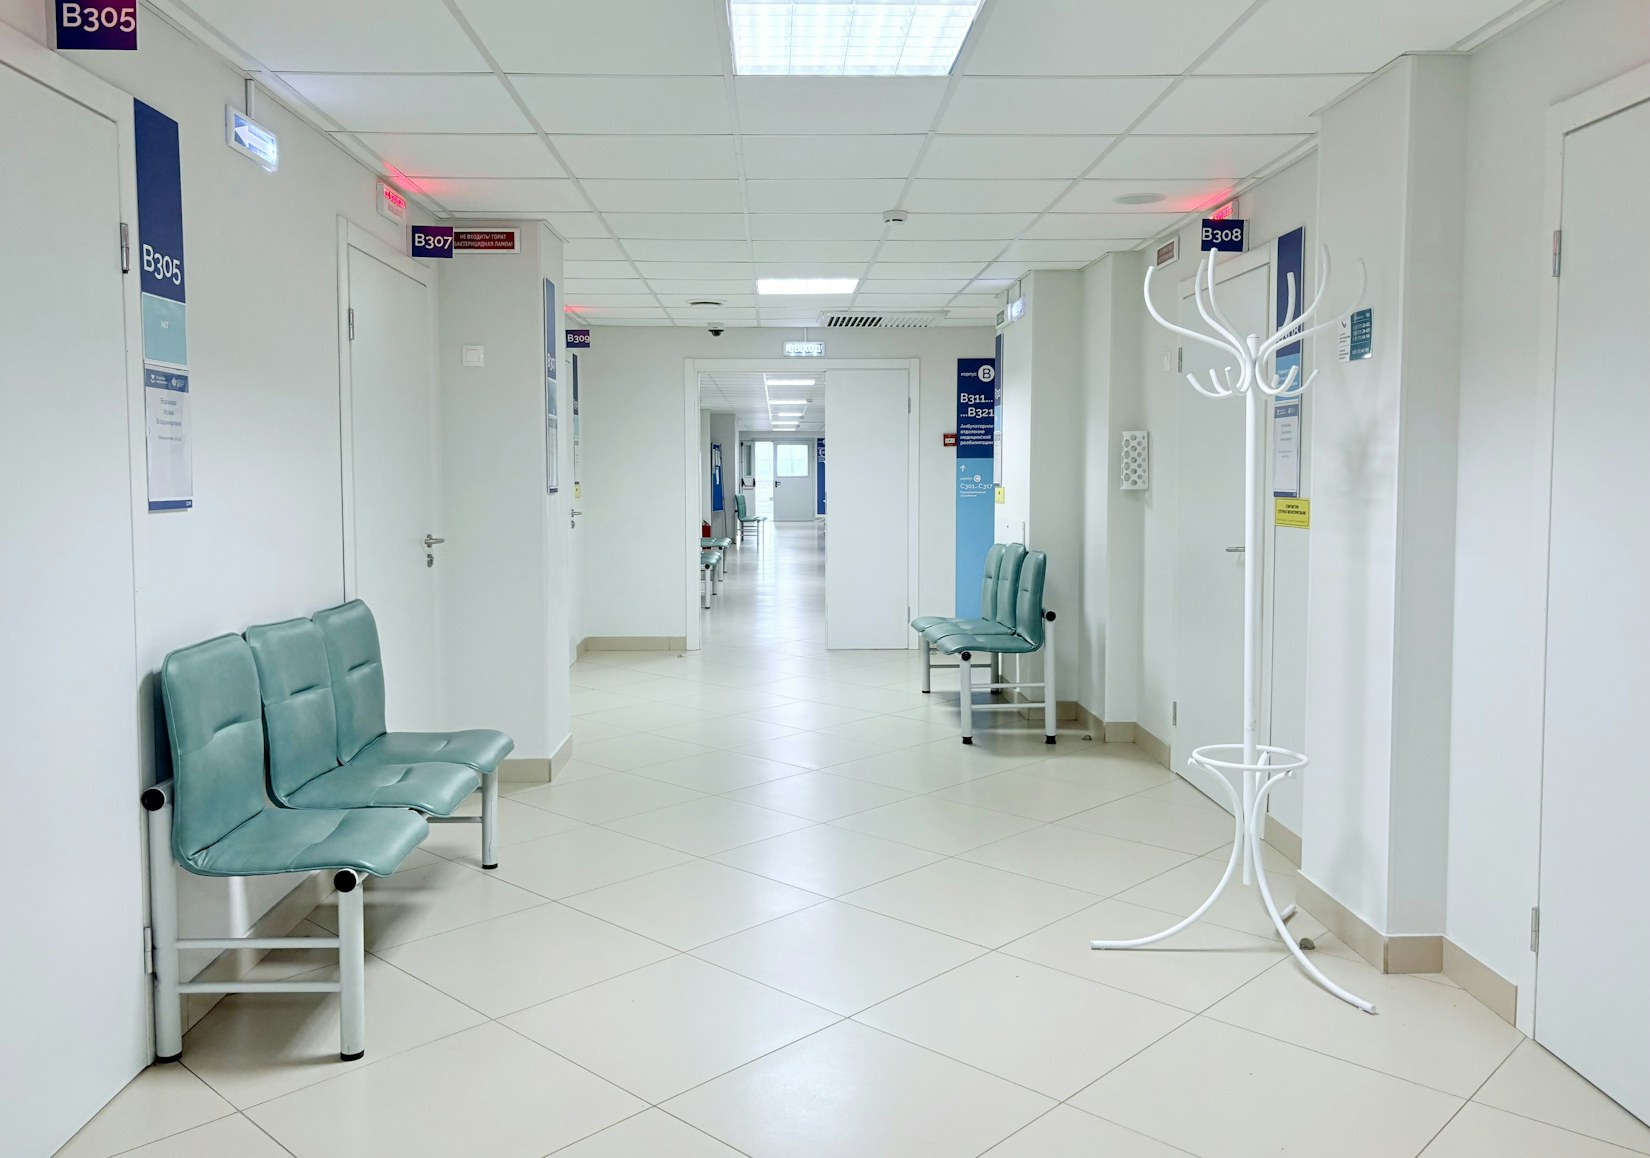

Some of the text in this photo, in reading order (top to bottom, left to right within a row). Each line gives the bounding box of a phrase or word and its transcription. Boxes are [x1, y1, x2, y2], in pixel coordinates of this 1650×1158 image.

[62, 3, 136, 33] B305
[414, 233, 453, 250] B307
[1202, 227, 1242, 243] B308
[142, 244, 181, 286] B305
[567, 334, 590, 344] B309
